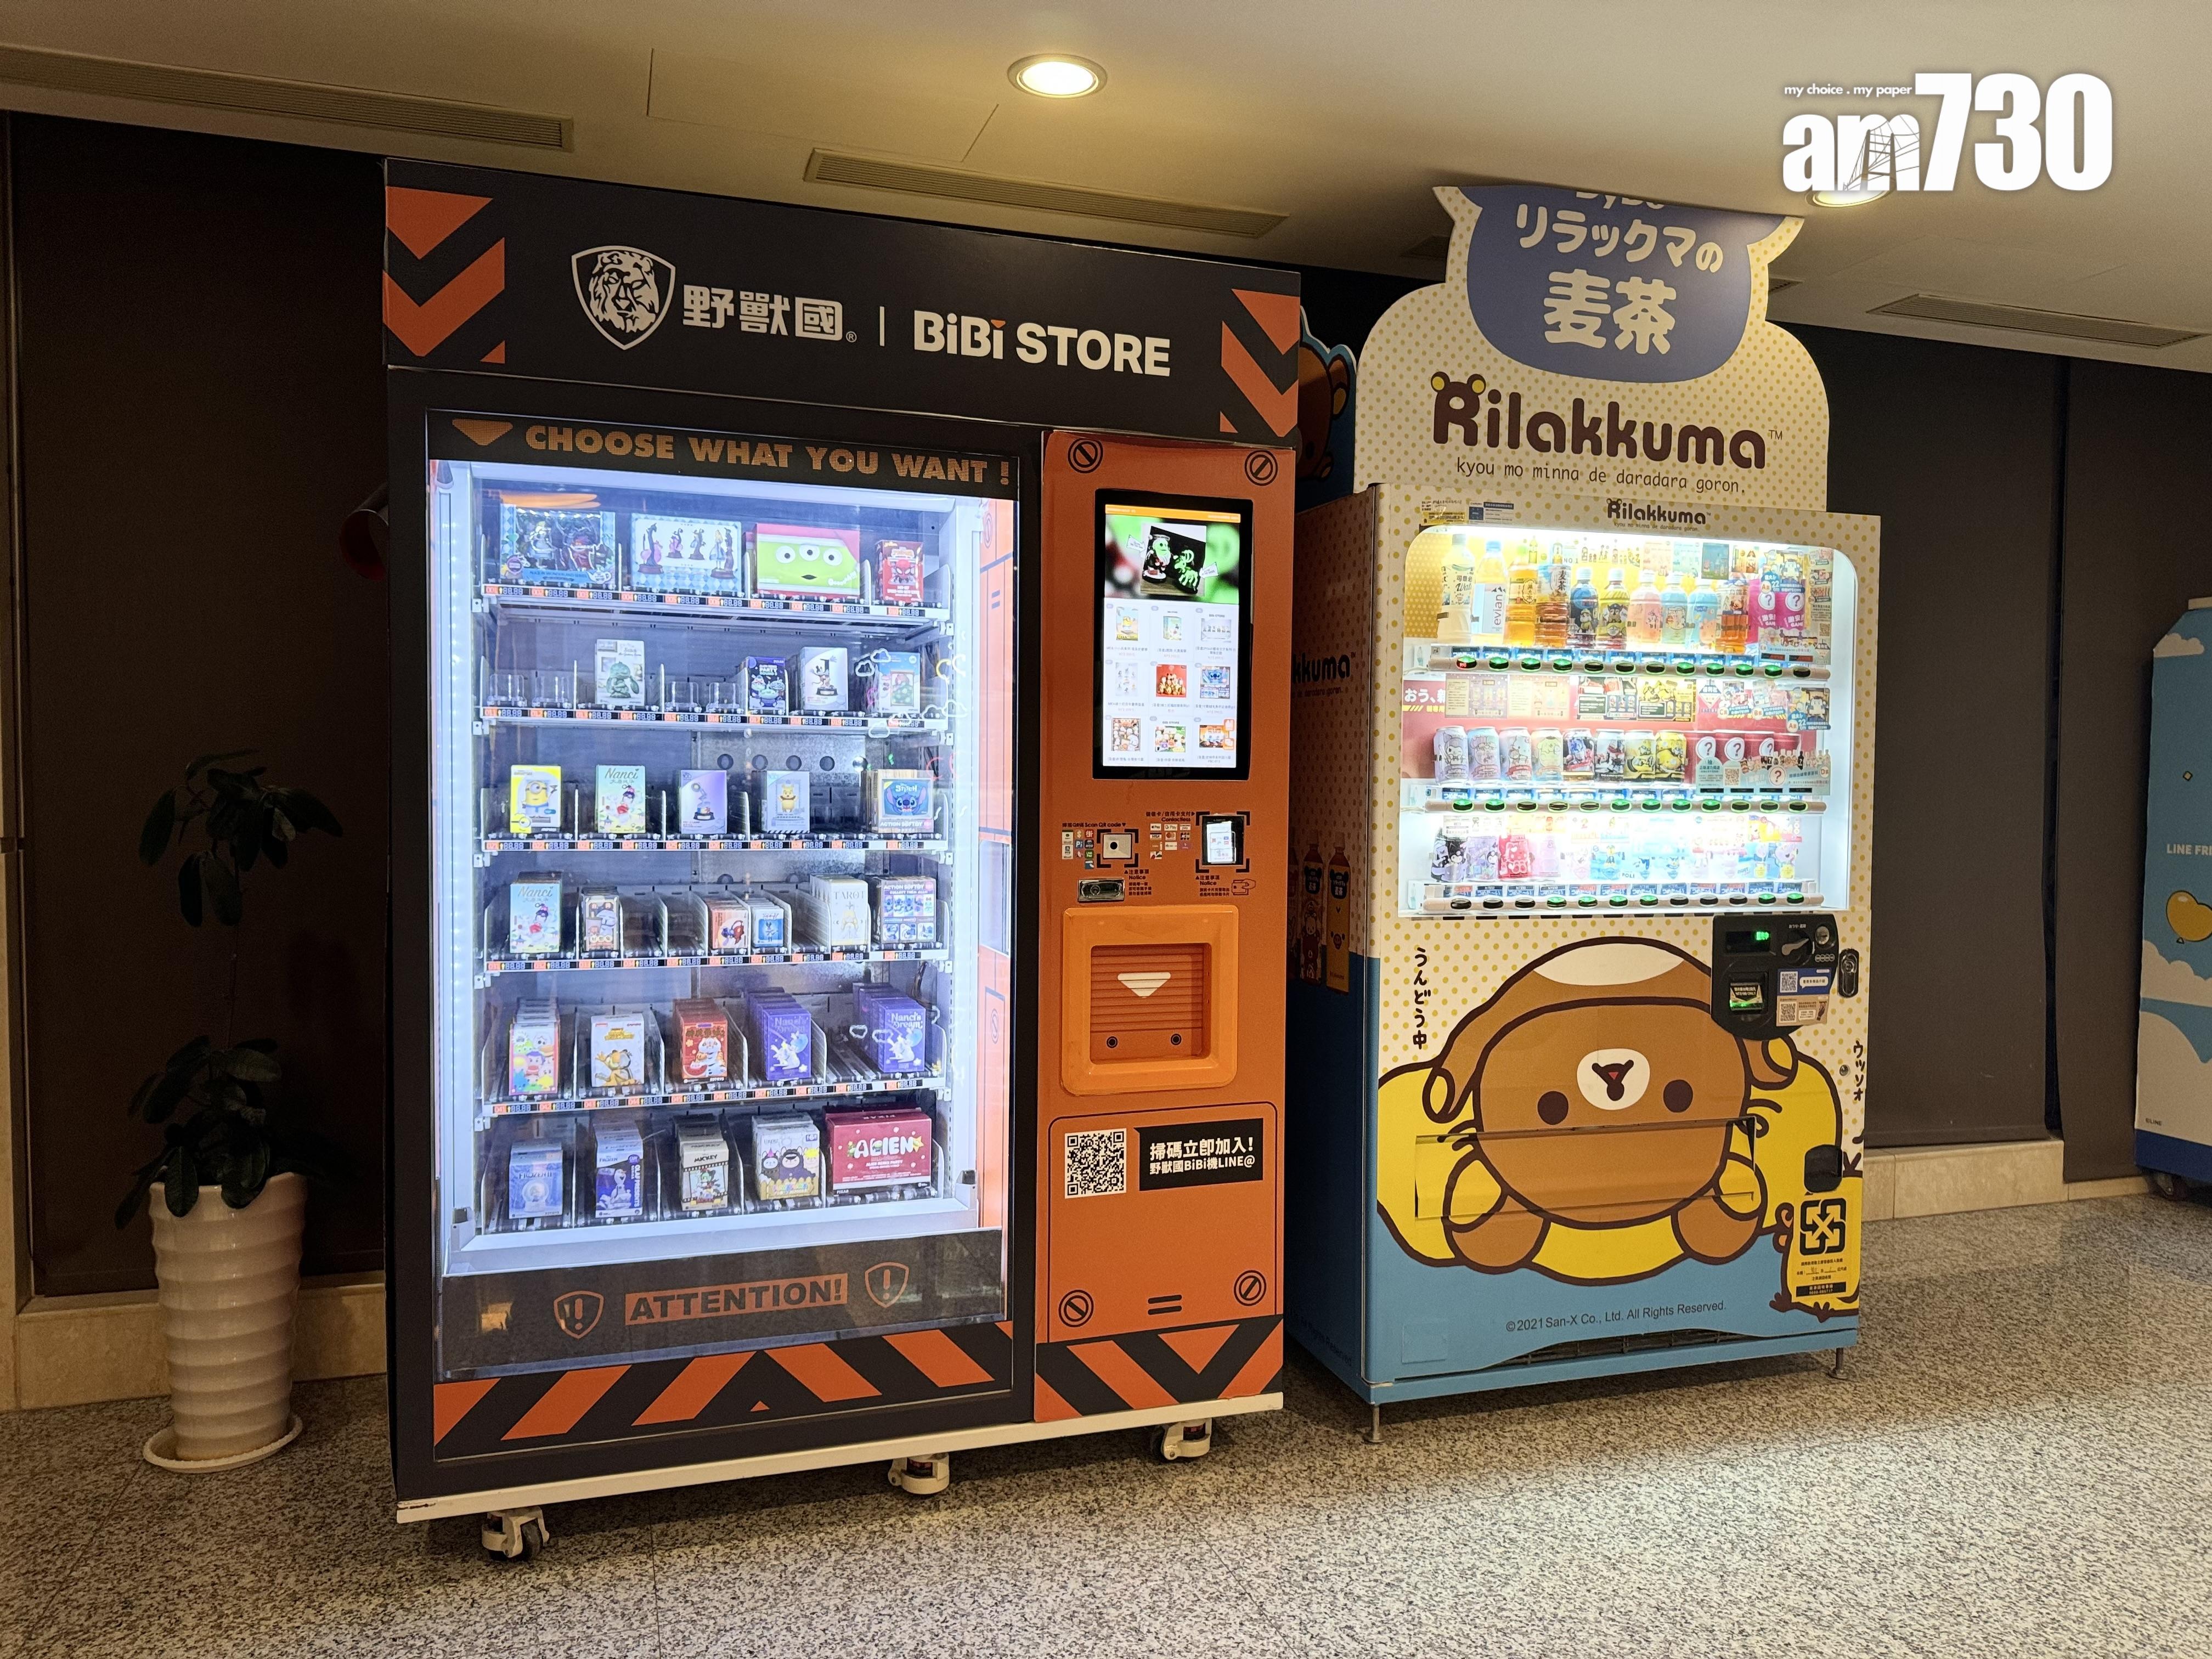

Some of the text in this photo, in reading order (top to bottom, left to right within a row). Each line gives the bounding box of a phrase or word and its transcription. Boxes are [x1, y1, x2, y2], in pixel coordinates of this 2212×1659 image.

[1517, 203, 1723, 273] リラックマの
[683, 285, 843, 341] 野獸國
[1543, 268, 1677, 355] 麦茶
[1015, 323, 1171, 377] STORE
[1431, 371, 1765, 469] Rilakkuma
[526, 425, 674, 460] CHOOSE
[687, 437, 793, 469] WHAT
[805, 446, 878, 475] YOU
[890, 453, 988, 483] WANT
[1457, 457, 1745, 494] kyou mo minna de daradara goron.
[1606, 498, 1706, 524] Rilakkuma
[1494, 595, 1503, 625] evian
[605, 768, 640, 779] Nanci
[2167, 844, 2192, 854] LINE
[518, 886, 554, 898] Nanci
[833, 890, 864, 900] TAROT
[1413, 947, 1431, 1049] うんどう中
[694, 1154, 718, 1163] MICKEY
[854, 1136, 913, 1158] ALIEN
[630, 1278, 842, 1321] ATTENTION!
[1545, 1314, 1577, 1328] San-X
[1581, 1313, 1602, 1324] Co.,
[1605, 1311, 1623, 1322] Ltd.
[1627, 1308, 1640, 1319] All
[1643, 1306, 1674, 1320] Rights
[1678, 1300, 1726, 1315] Reserved.
